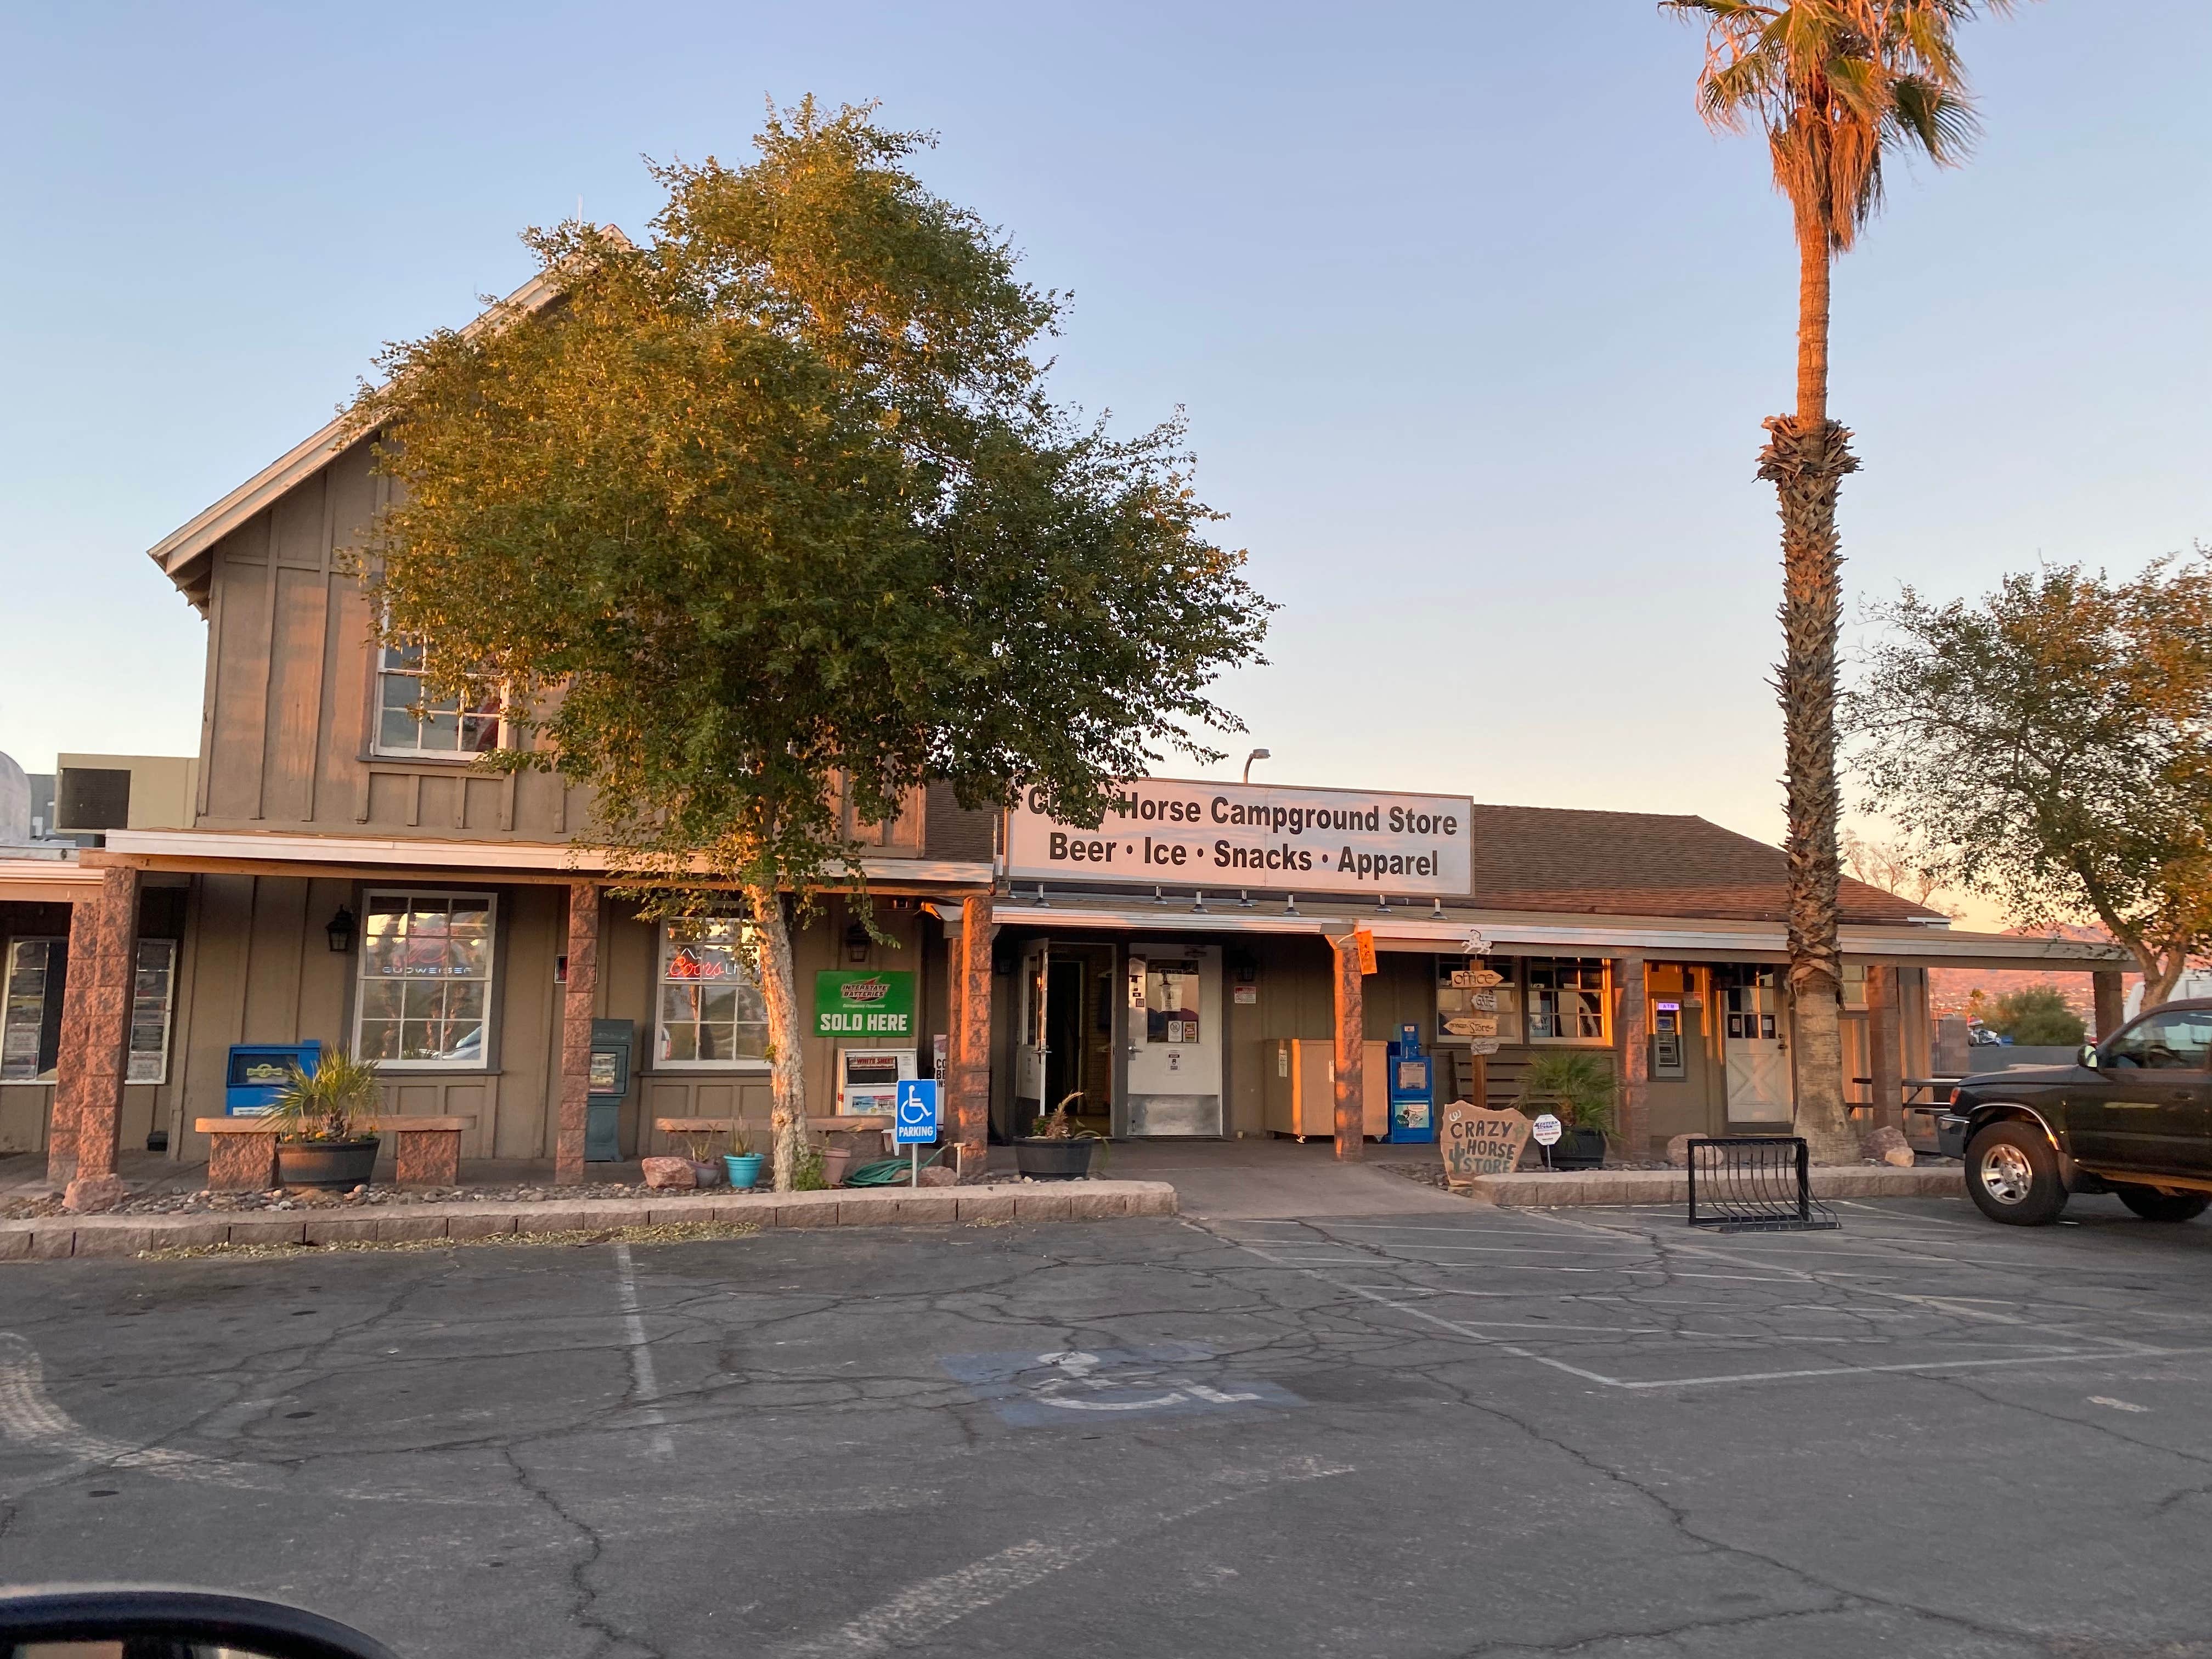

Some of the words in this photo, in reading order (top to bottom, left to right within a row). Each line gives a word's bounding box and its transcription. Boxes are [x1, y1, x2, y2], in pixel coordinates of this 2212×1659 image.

[1120, 791, 1201, 822] Horse
[1211, 796, 1379, 834] Campground
[1389, 806, 1457, 835] Store
[1049, 832, 1116, 862] Beer
[1144, 837, 1187, 865] Ice
[1214, 839, 1312, 871] Snacks
[1338, 846, 1438, 880] Apparel
[669, 956, 724, 976] Coors
[820, 1013, 863, 1031] SOLD
[867, 1014, 908, 1031] HERE
[899, 1126, 933, 1137] PARKING
[1450, 1120, 1513, 1139] CRAZY
[1466, 1138, 1516, 1160] HORSE
[1463, 1157, 1510, 1175] STORE
